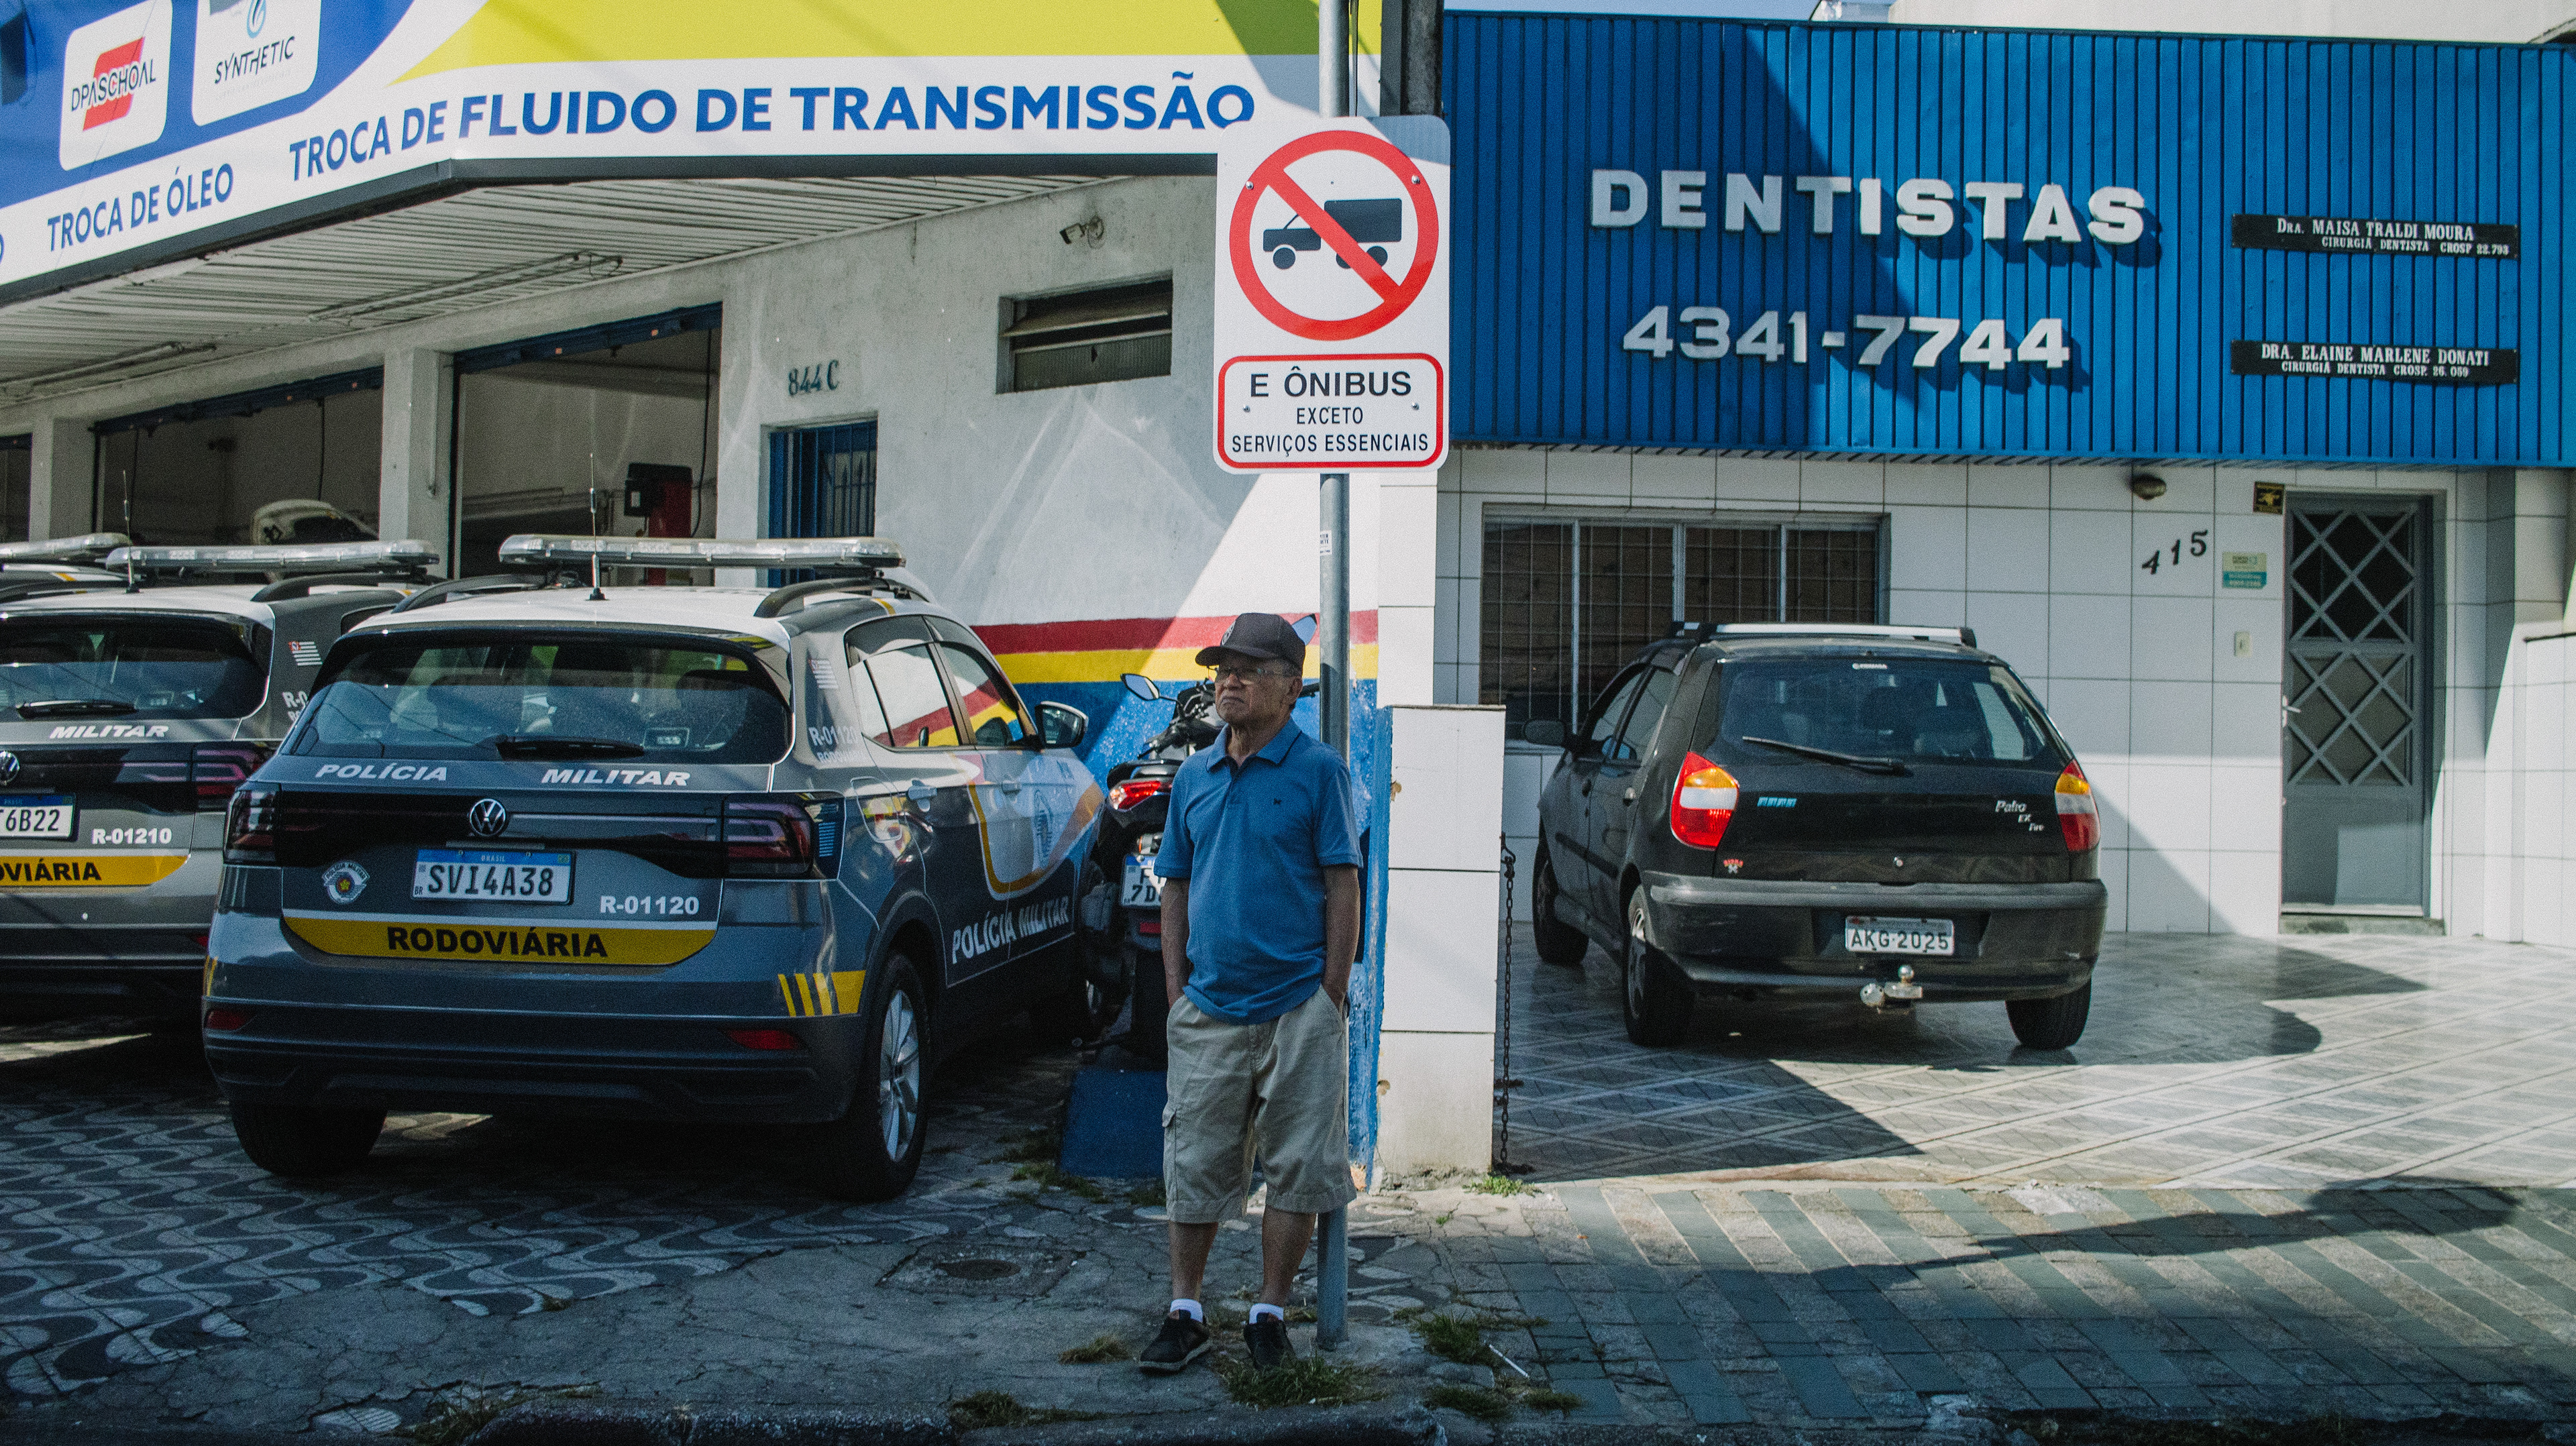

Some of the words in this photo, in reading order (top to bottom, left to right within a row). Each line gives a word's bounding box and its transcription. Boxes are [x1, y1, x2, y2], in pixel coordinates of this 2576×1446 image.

[215, 36, 295, 84] SYNTHETIC
[72, 58, 156, 111] DPASCHOAL
[290, 116, 391, 181] TROCA
[401, 100, 447, 151] DE
[459, 89, 678, 138] FLUIDO
[696, 88, 772, 133] DE
[790, 71, 1254, 131] TRANSMISSÃO
[47, 196, 123, 252] TROCA
[131, 185, 160, 229] DE
[167, 163, 233, 217] ÓLEO
[1591, 168, 2145, 245] DENTISTAS
[2312, 219, 2360, 237] MAISA
[2366, 221, 2418, 239] TRALDI
[2424, 224, 2474, 241] MOURA
[2380, 239, 2429, 252] DENTISTA
[1623, 305, 2070, 370] 4341-7744
[2261, 343, 2294, 359] DRA.
[2302, 345, 2353, 362] ELAINE
[2361, 347, 2430, 364] MARLENE
[2438, 349, 2489, 366] DONATI
[1250, 374, 1269, 397] E
[1285, 366, 1411, 396] ÔNIBUS
[2337, 363, 2385, 376] DENTISTA
[1297, 407, 1363, 425] EXCETO
[1232, 435, 1317, 457] SERVIÇOS
[1325, 434, 1428, 452] ESSENCIAIS
[2142, 529, 2208, 575] 415
[50, 725, 170, 738] MILITAR
[315, 761, 448, 782] POLÍCIA
[541, 768, 691, 787] MILITAR
[1995, 800, 2027, 812] Palio
[92, 828, 172, 844] R-01210
[414, 886, 423, 895] BR
[428, 865, 554, 896] SVI4A38
[600, 895, 700, 915] R-01120
[387, 926, 608, 958] RODOVIÁRIA
[952, 911, 1017, 964] POLÍCIA
[1018, 895, 1069, 938] MILITAR
